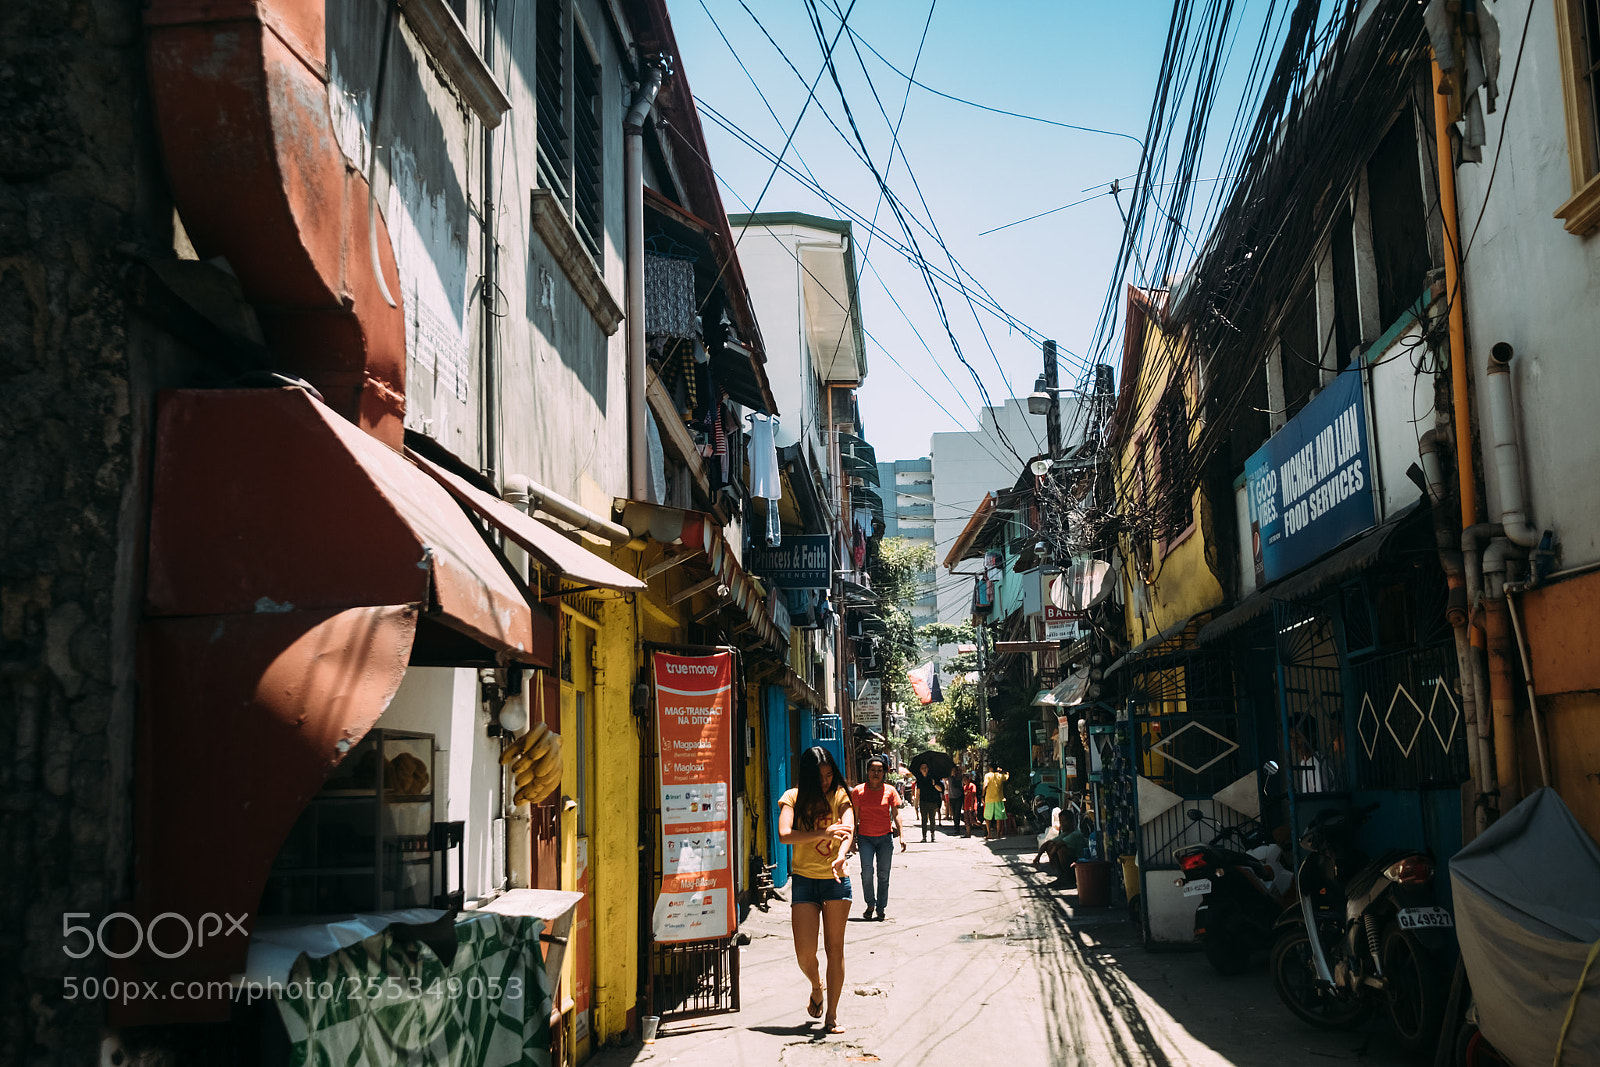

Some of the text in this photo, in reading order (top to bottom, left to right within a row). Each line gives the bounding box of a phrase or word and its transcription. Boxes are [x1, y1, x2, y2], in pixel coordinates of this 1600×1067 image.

[1280, 402, 1360, 508] MICHAEL AND LIAN
[1256, 469, 1277, 502] GOOD
[1284, 459, 1364, 538] FOOD SERVICES
[1257, 496, 1278, 530] VIBES.
[756, 545, 827, 569] Princess & Faith
[665, 661, 718, 678] truemoney
[664, 706, 723, 716] MAG-TRANSACT
[677, 716, 690, 725] NA
[673, 739, 712, 751] Magpadala
[673, 762, 704, 774] Magload
[1400, 913, 1450, 927] GA 49527
